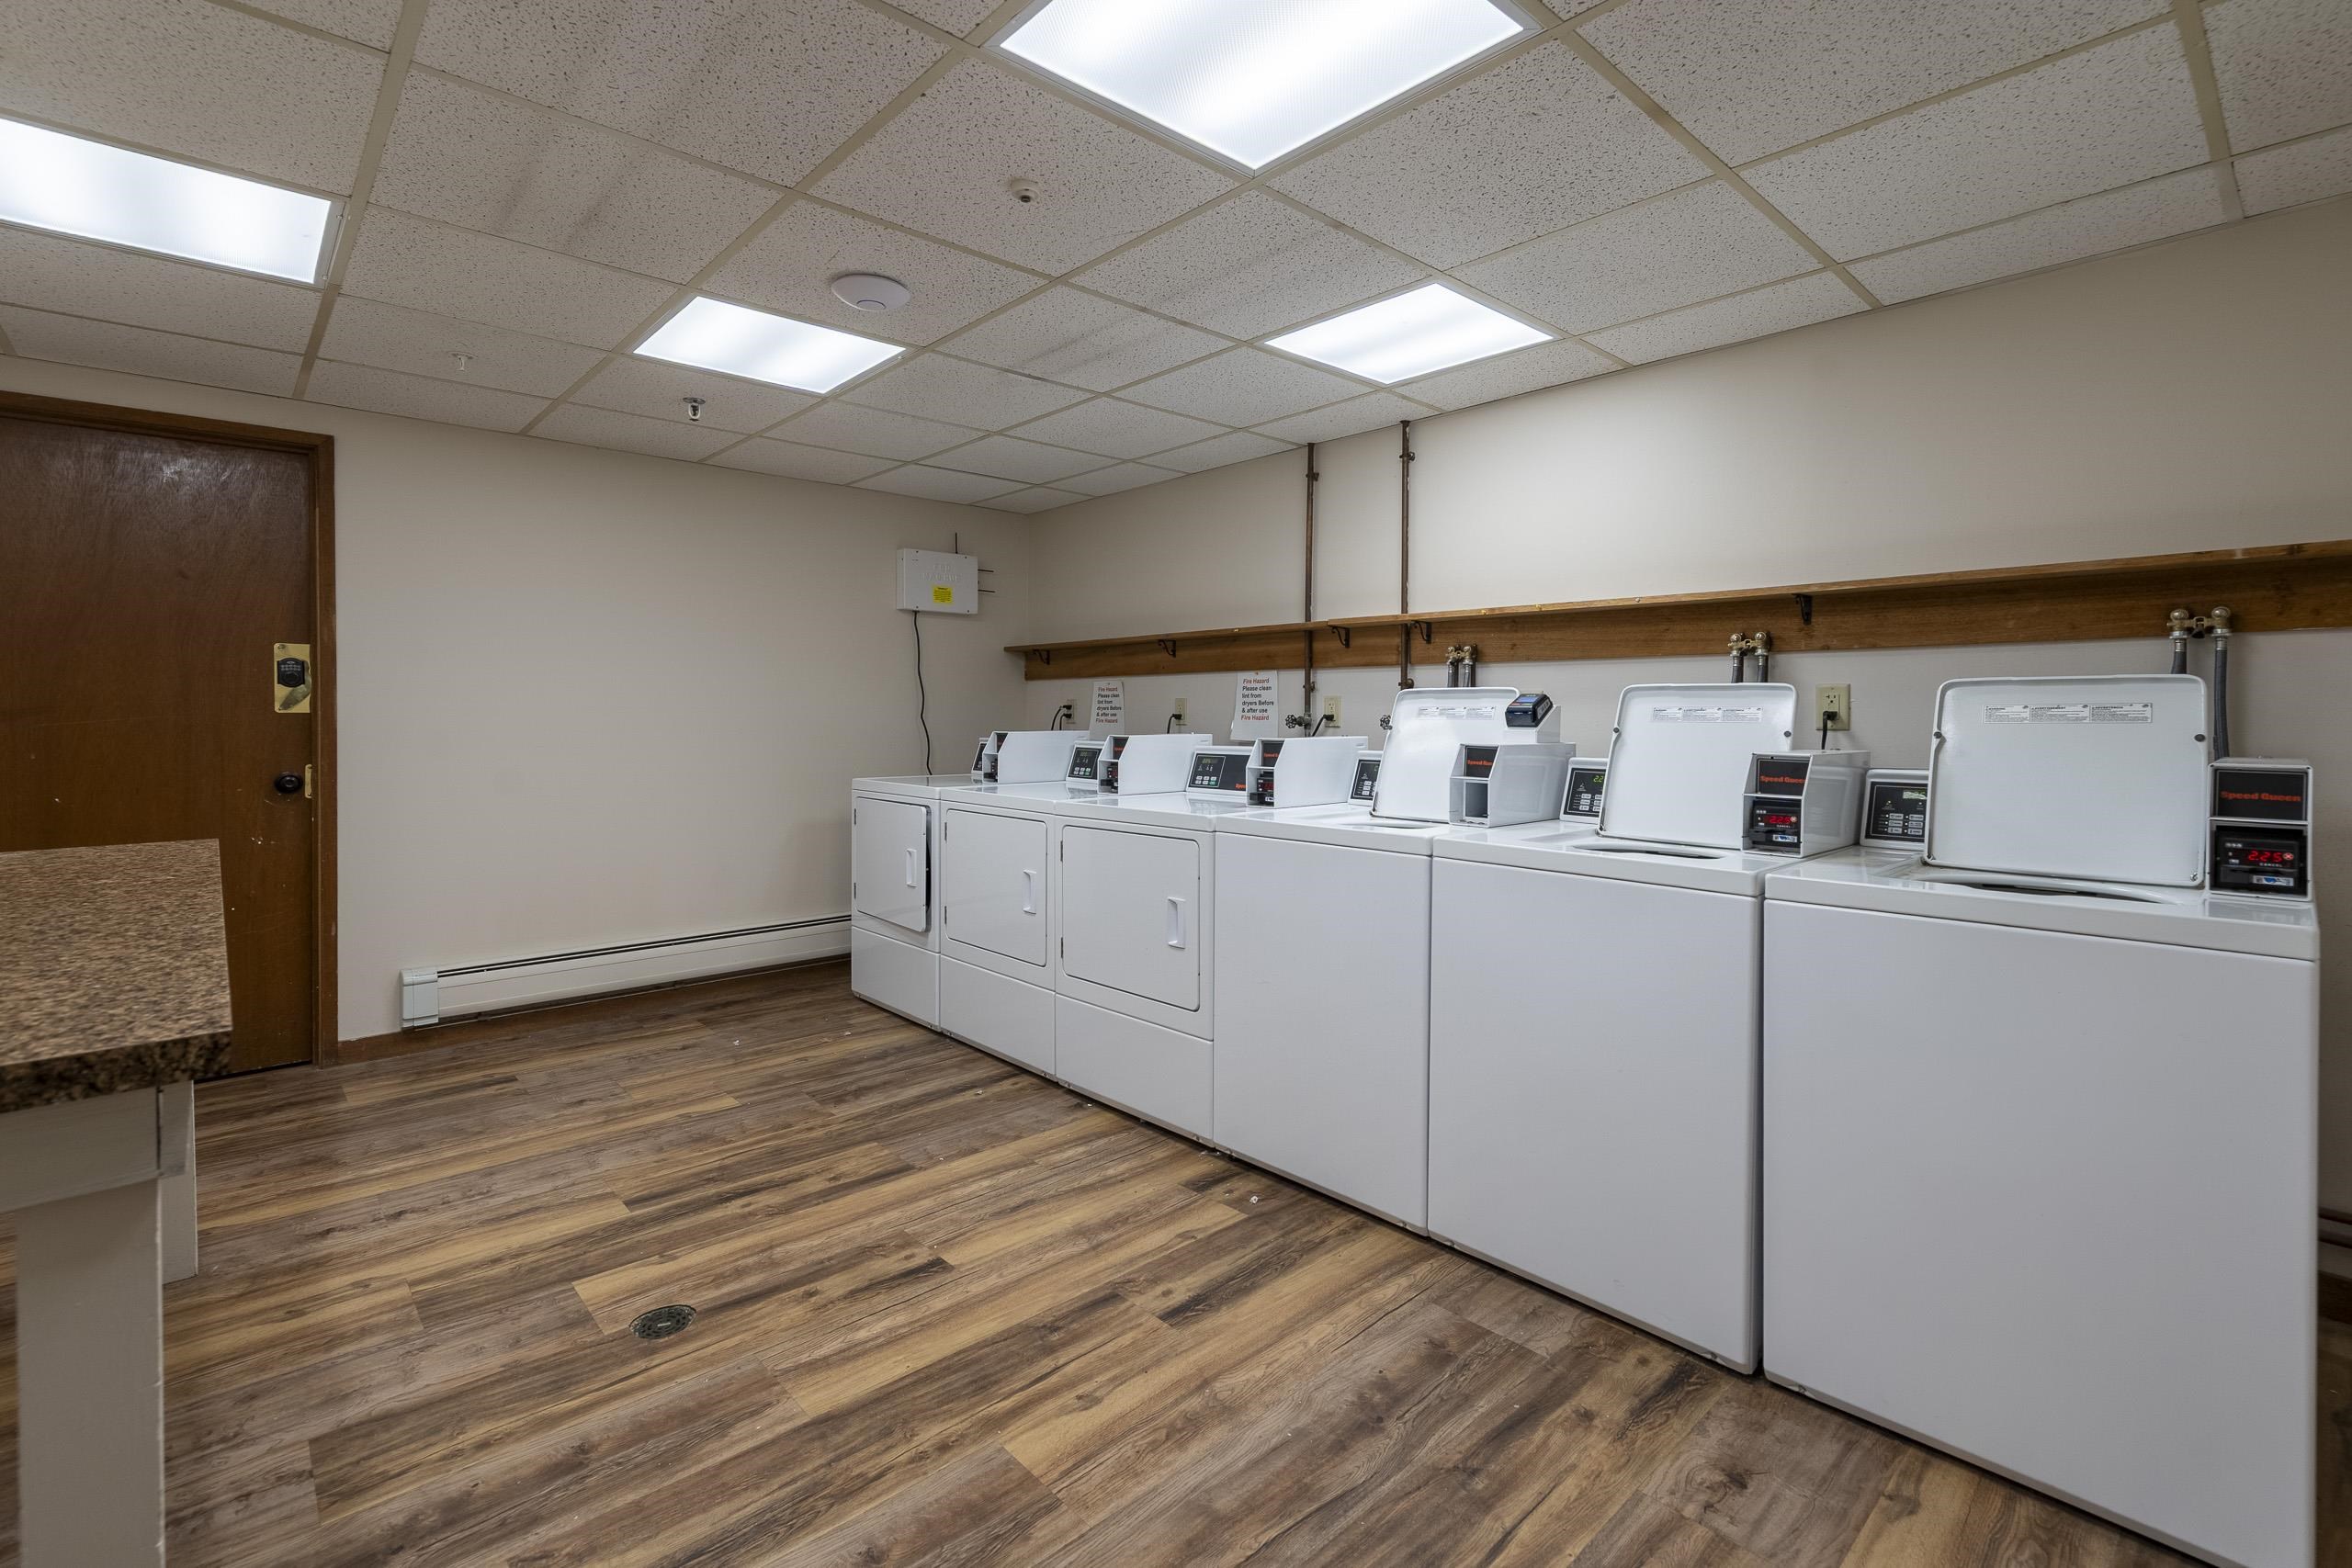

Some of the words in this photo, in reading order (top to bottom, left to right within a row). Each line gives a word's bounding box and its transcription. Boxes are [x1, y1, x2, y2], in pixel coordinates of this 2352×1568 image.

[2221, 791, 2258, 800] Speed
[2260, 793, 2301, 801] Queen
[2248, 851, 2283, 862] 2.25
